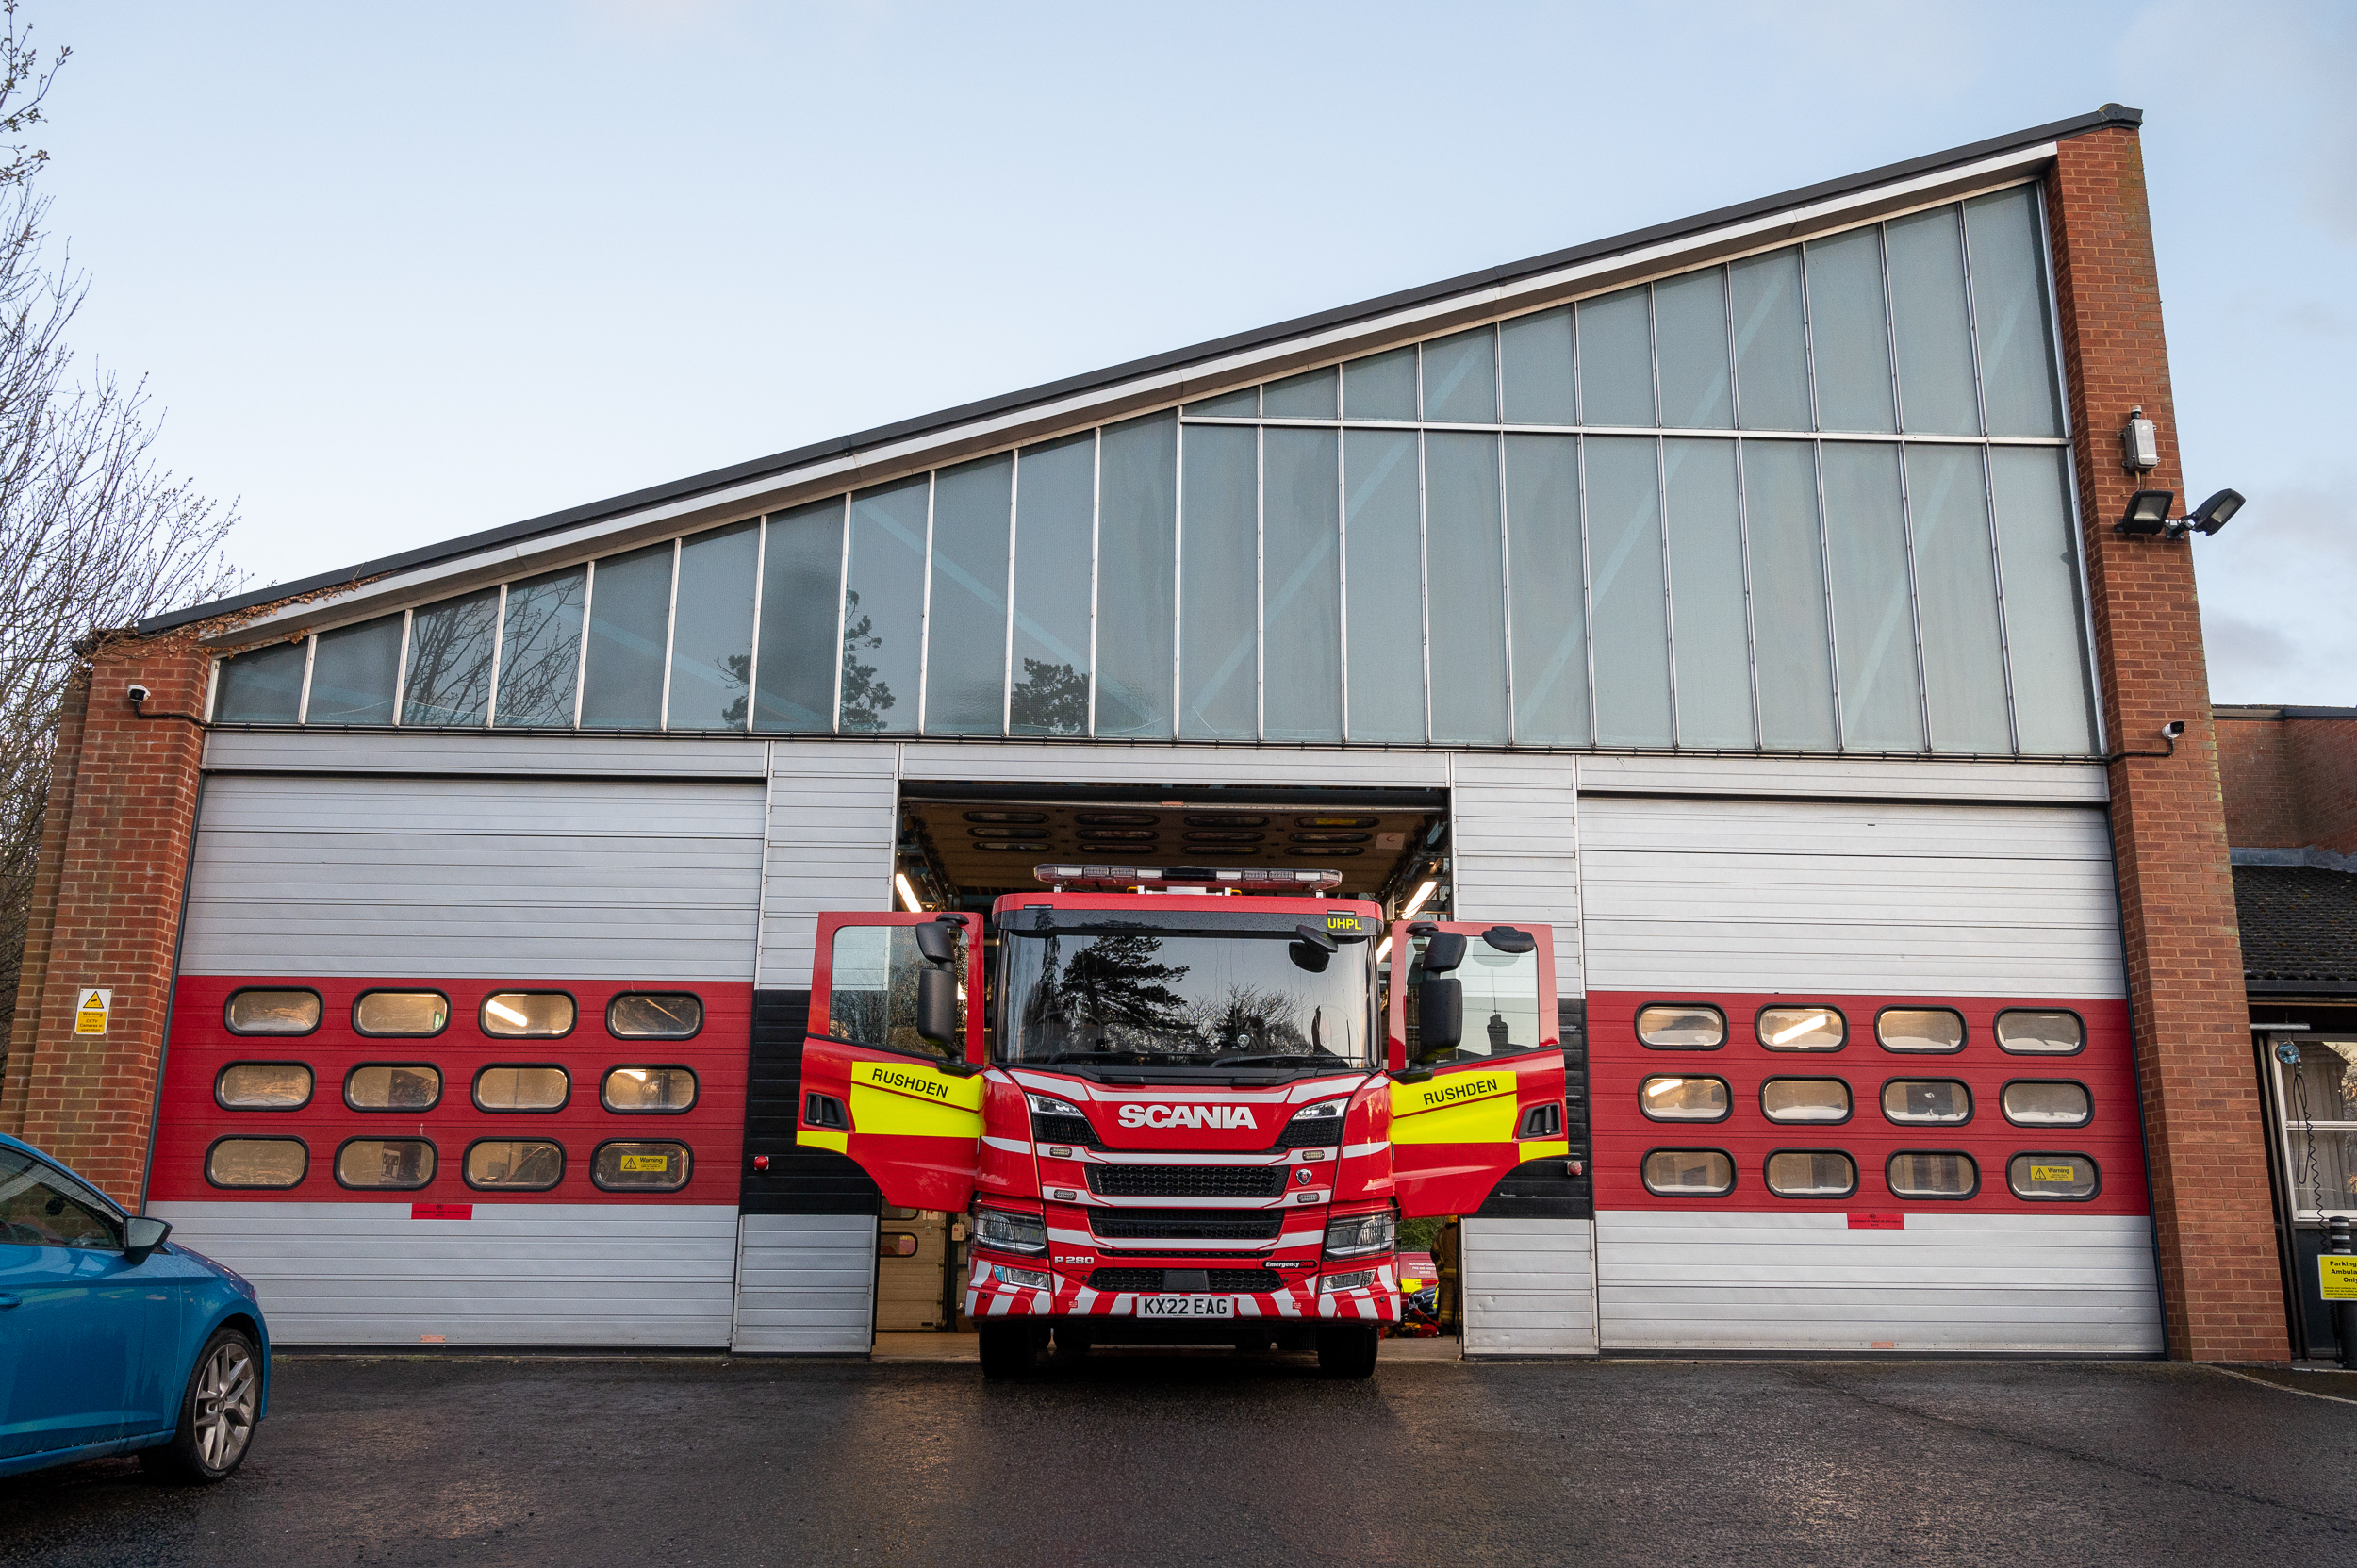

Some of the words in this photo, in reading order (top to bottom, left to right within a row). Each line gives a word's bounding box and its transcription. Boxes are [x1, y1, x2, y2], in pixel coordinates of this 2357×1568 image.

[1327, 917, 1362, 931] UHPL
[872, 1068, 948, 1098] RUSHDEN
[1423, 1079, 1498, 1105] RUSHDEN
[1117, 1104, 1258, 1129] SCANIA
[1054, 1256, 1064, 1264] P
[1065, 1256, 1095, 1264] 280
[1144, 1298, 1189, 1314] KX22
[1194, 1298, 1227, 1314] EAG
